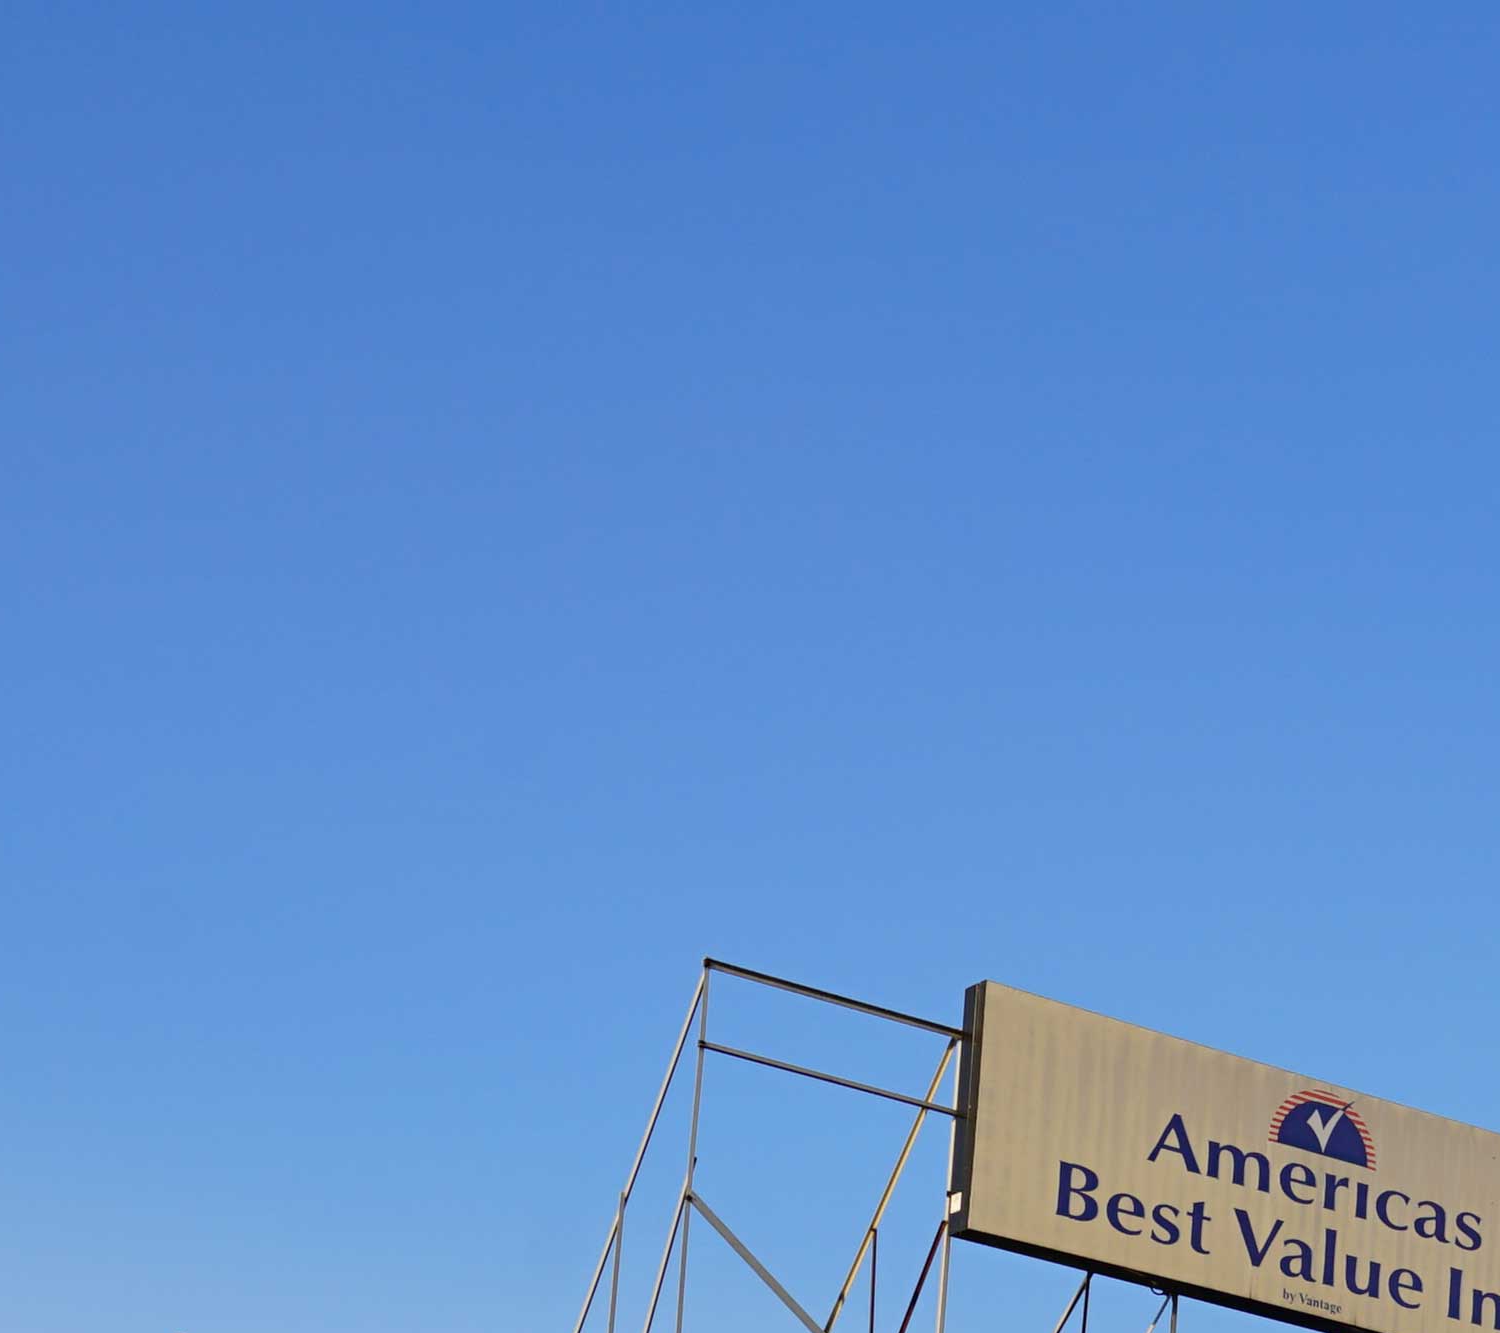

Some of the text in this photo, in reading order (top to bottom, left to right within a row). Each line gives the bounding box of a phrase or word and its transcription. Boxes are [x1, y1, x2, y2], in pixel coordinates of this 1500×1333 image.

[1055, 1161, 1211, 1255] Best
[1233, 1208, 1423, 1310] Value
[1147, 1113, 1483, 1251] Americas
[1282, 1288, 1343, 1315] by Vantage
